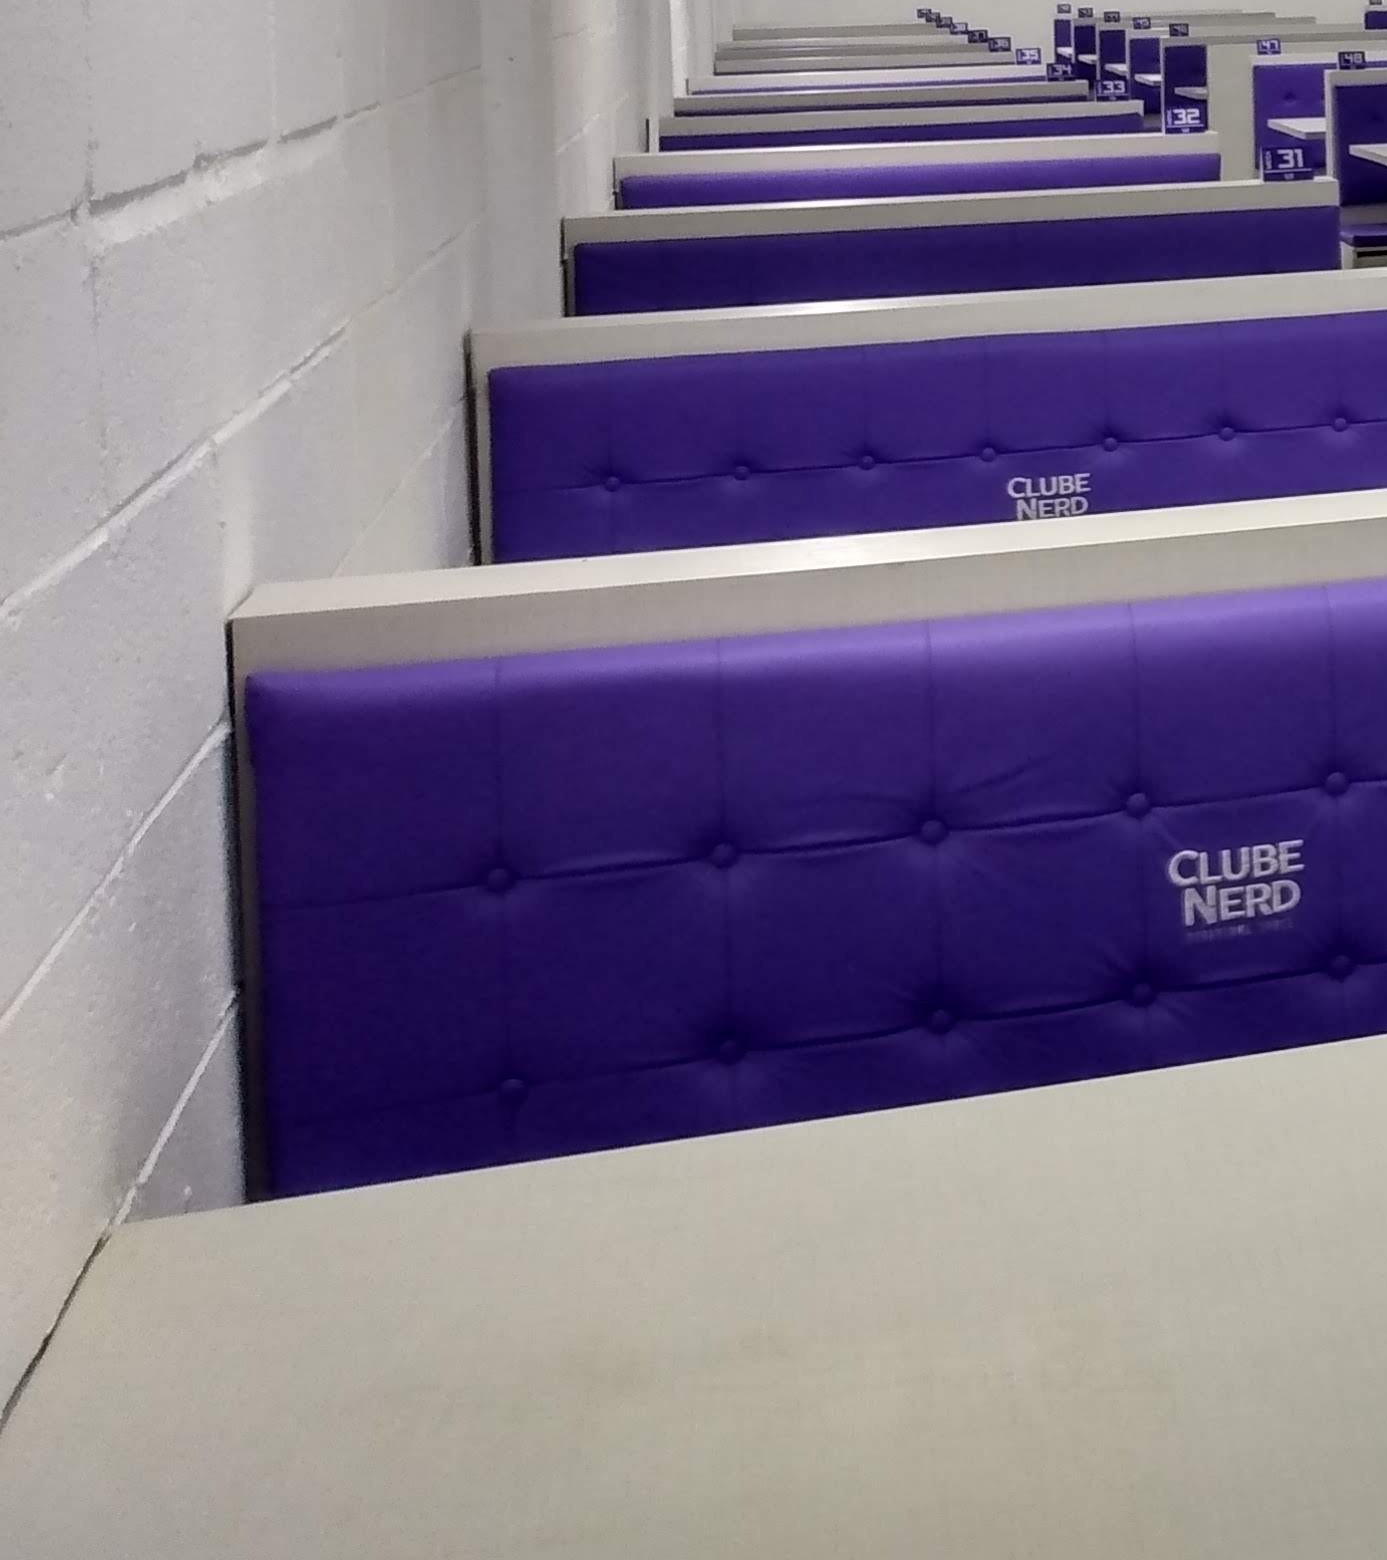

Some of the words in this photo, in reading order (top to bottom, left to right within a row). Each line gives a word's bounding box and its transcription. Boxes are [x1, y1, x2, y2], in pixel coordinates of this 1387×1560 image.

[1022, 49, 1039, 60] 35
[1053, 64, 1073, 76] 34
[1102, 80, 1126, 93] 33
[1172, 108, 1200, 125] 32
[1277, 148, 1304, 169] 31
[1007, 472, 1092, 499] CLUBE
[1016, 496, 1089, 521] NERD
[1167, 839, 1306, 887] CLUBE
[1182, 879, 1303, 927] NERD
